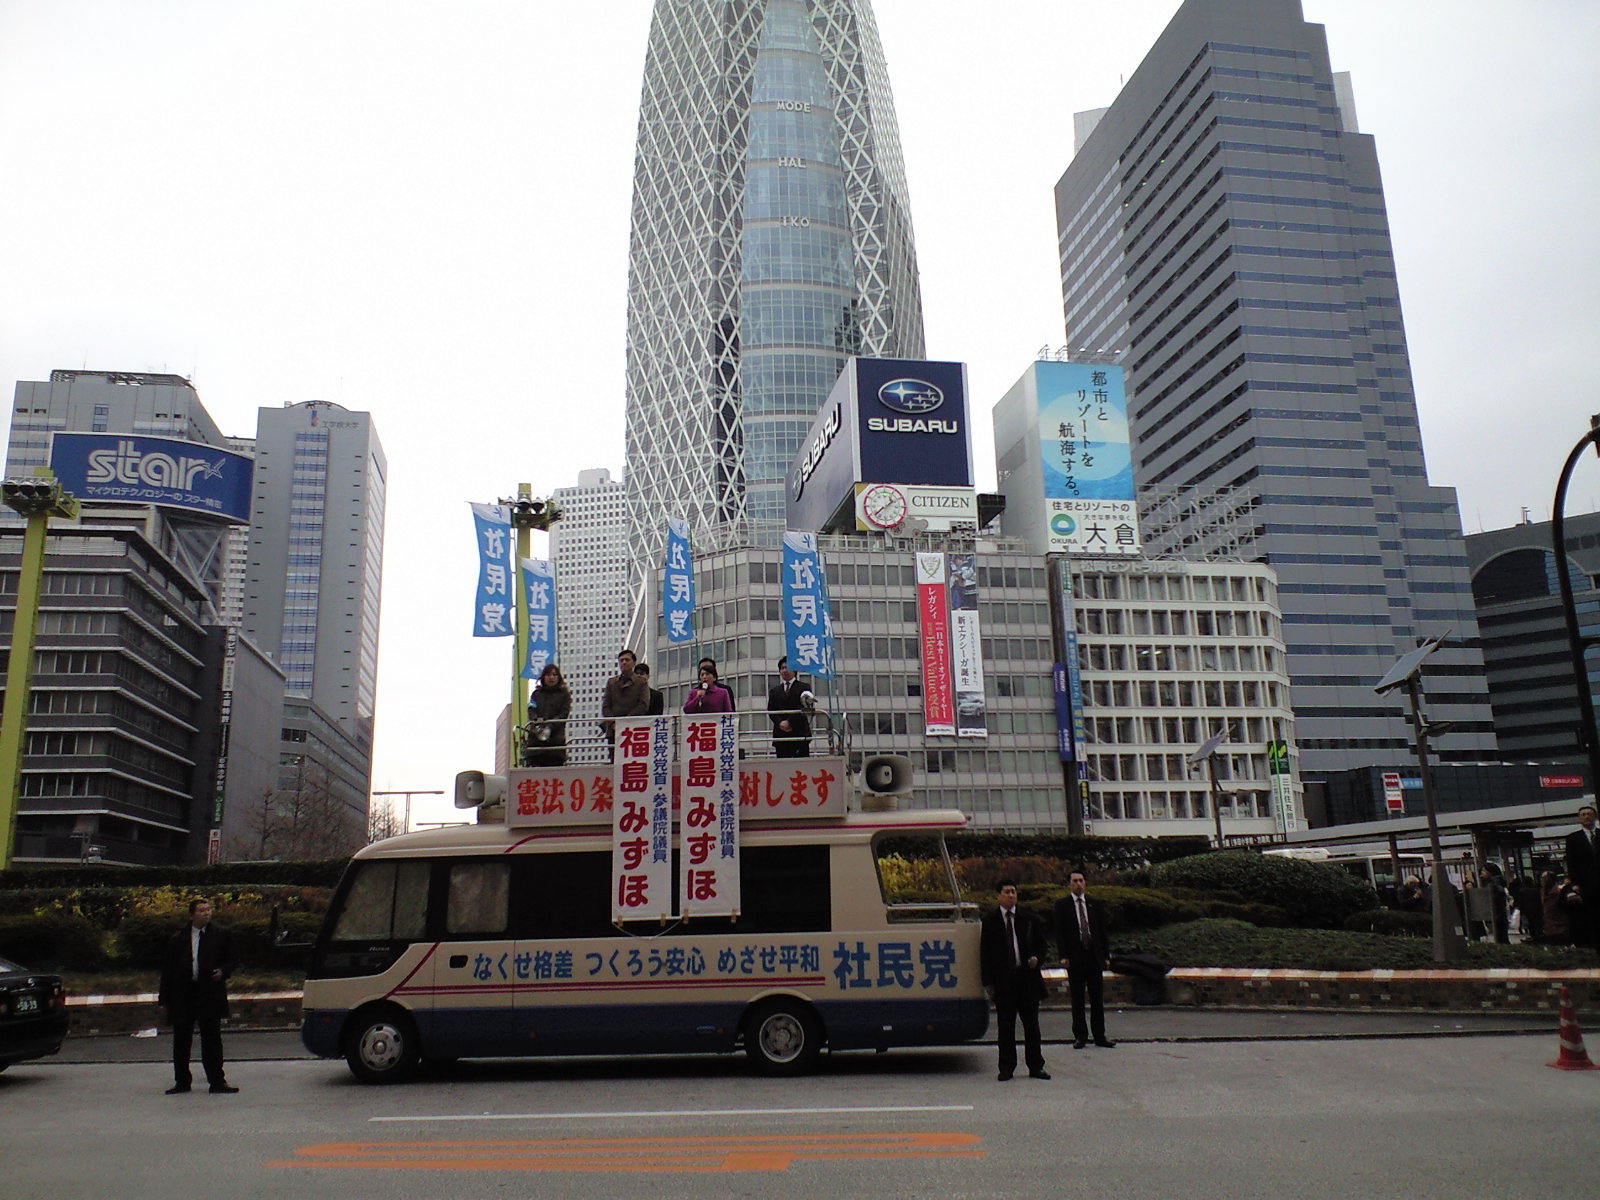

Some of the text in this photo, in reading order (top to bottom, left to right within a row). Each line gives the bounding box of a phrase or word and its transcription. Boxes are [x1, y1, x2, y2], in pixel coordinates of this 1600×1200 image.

[776, 101, 812, 113] MODE
[778, 156, 806, 168] HAL
[782, 216, 810, 228] IKO
[1091, 370, 1109, 421] 都市と
[801, 402, 841, 482] SUBARU
[868, 418, 958, 434] SUBARU
[1077, 389, 1094, 467] リゾートを
[86, 440, 206, 491] star
[1058, 422, 1080, 496] 航海する。
[86, 486, 183, 502] マイクロテクノロジーの
[911, 495, 970, 508] CITIZEN
[1052, 501, 1130, 512] 住宅とリゾートの
[1085, 522, 1135, 545] 大倉
[926, 636, 936, 660] Best
[927, 661, 938, 693] Value
[652, 718, 668, 864] 社民党党首・参議院議員
[720, 715, 735, 859] 社民党党首・参議院議員
[618, 726, 651, 907] 福島みずほ
[686, 722, 717, 901] 福島みずほ
[473, 940, 958, 990] なくせ格差 つくろう安心 めざせ平和 社民党
